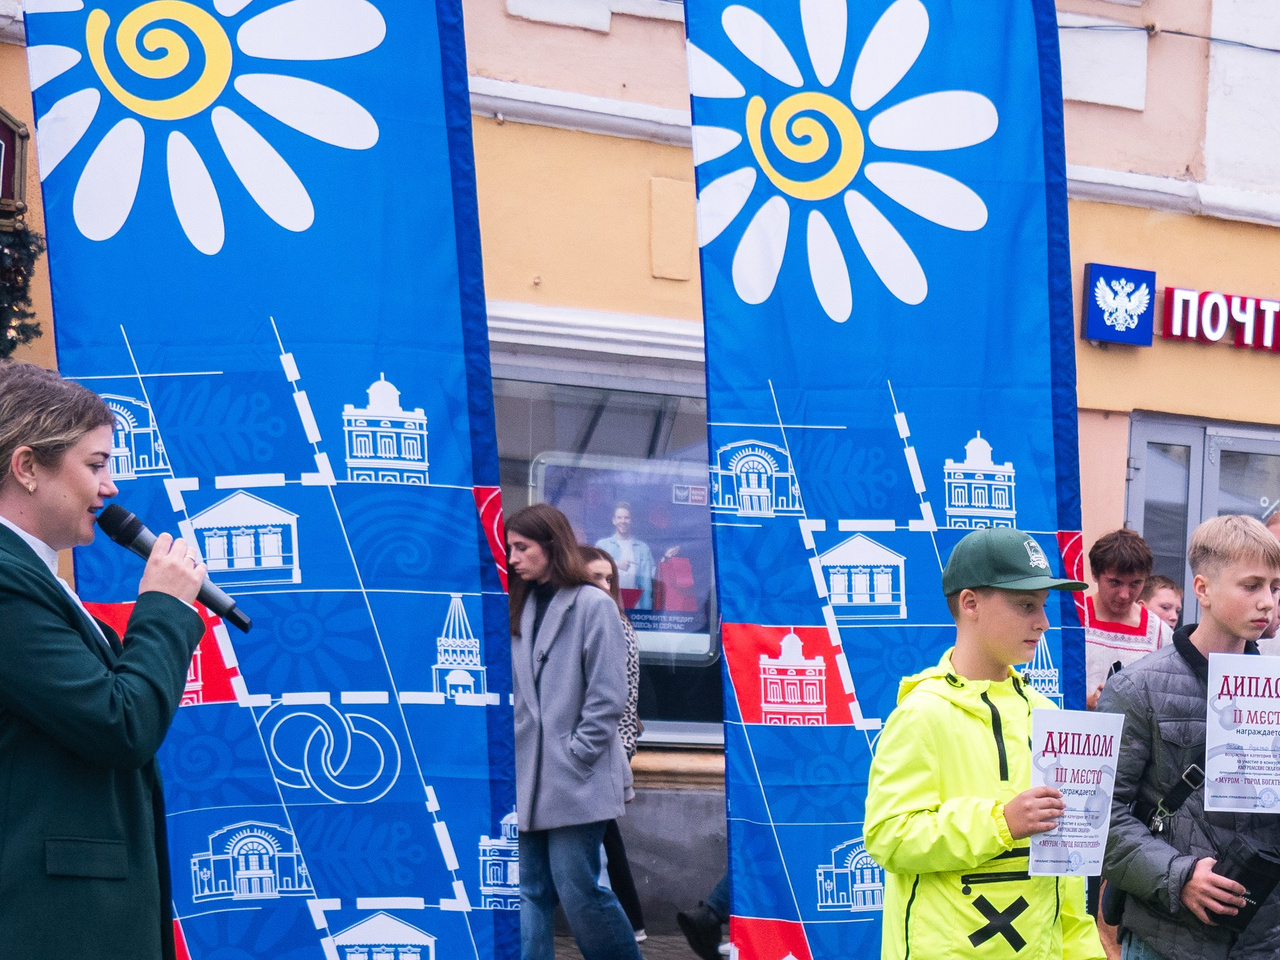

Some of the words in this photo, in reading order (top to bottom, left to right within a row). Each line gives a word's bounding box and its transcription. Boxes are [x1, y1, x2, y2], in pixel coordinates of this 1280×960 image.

[1233, 709, 1243, 724] II
[1042, 731, 1114, 758] ДИПЛОМ
[1055, 767, 1067, 783] III
[1070, 768, 1103, 785] МЕСТО
